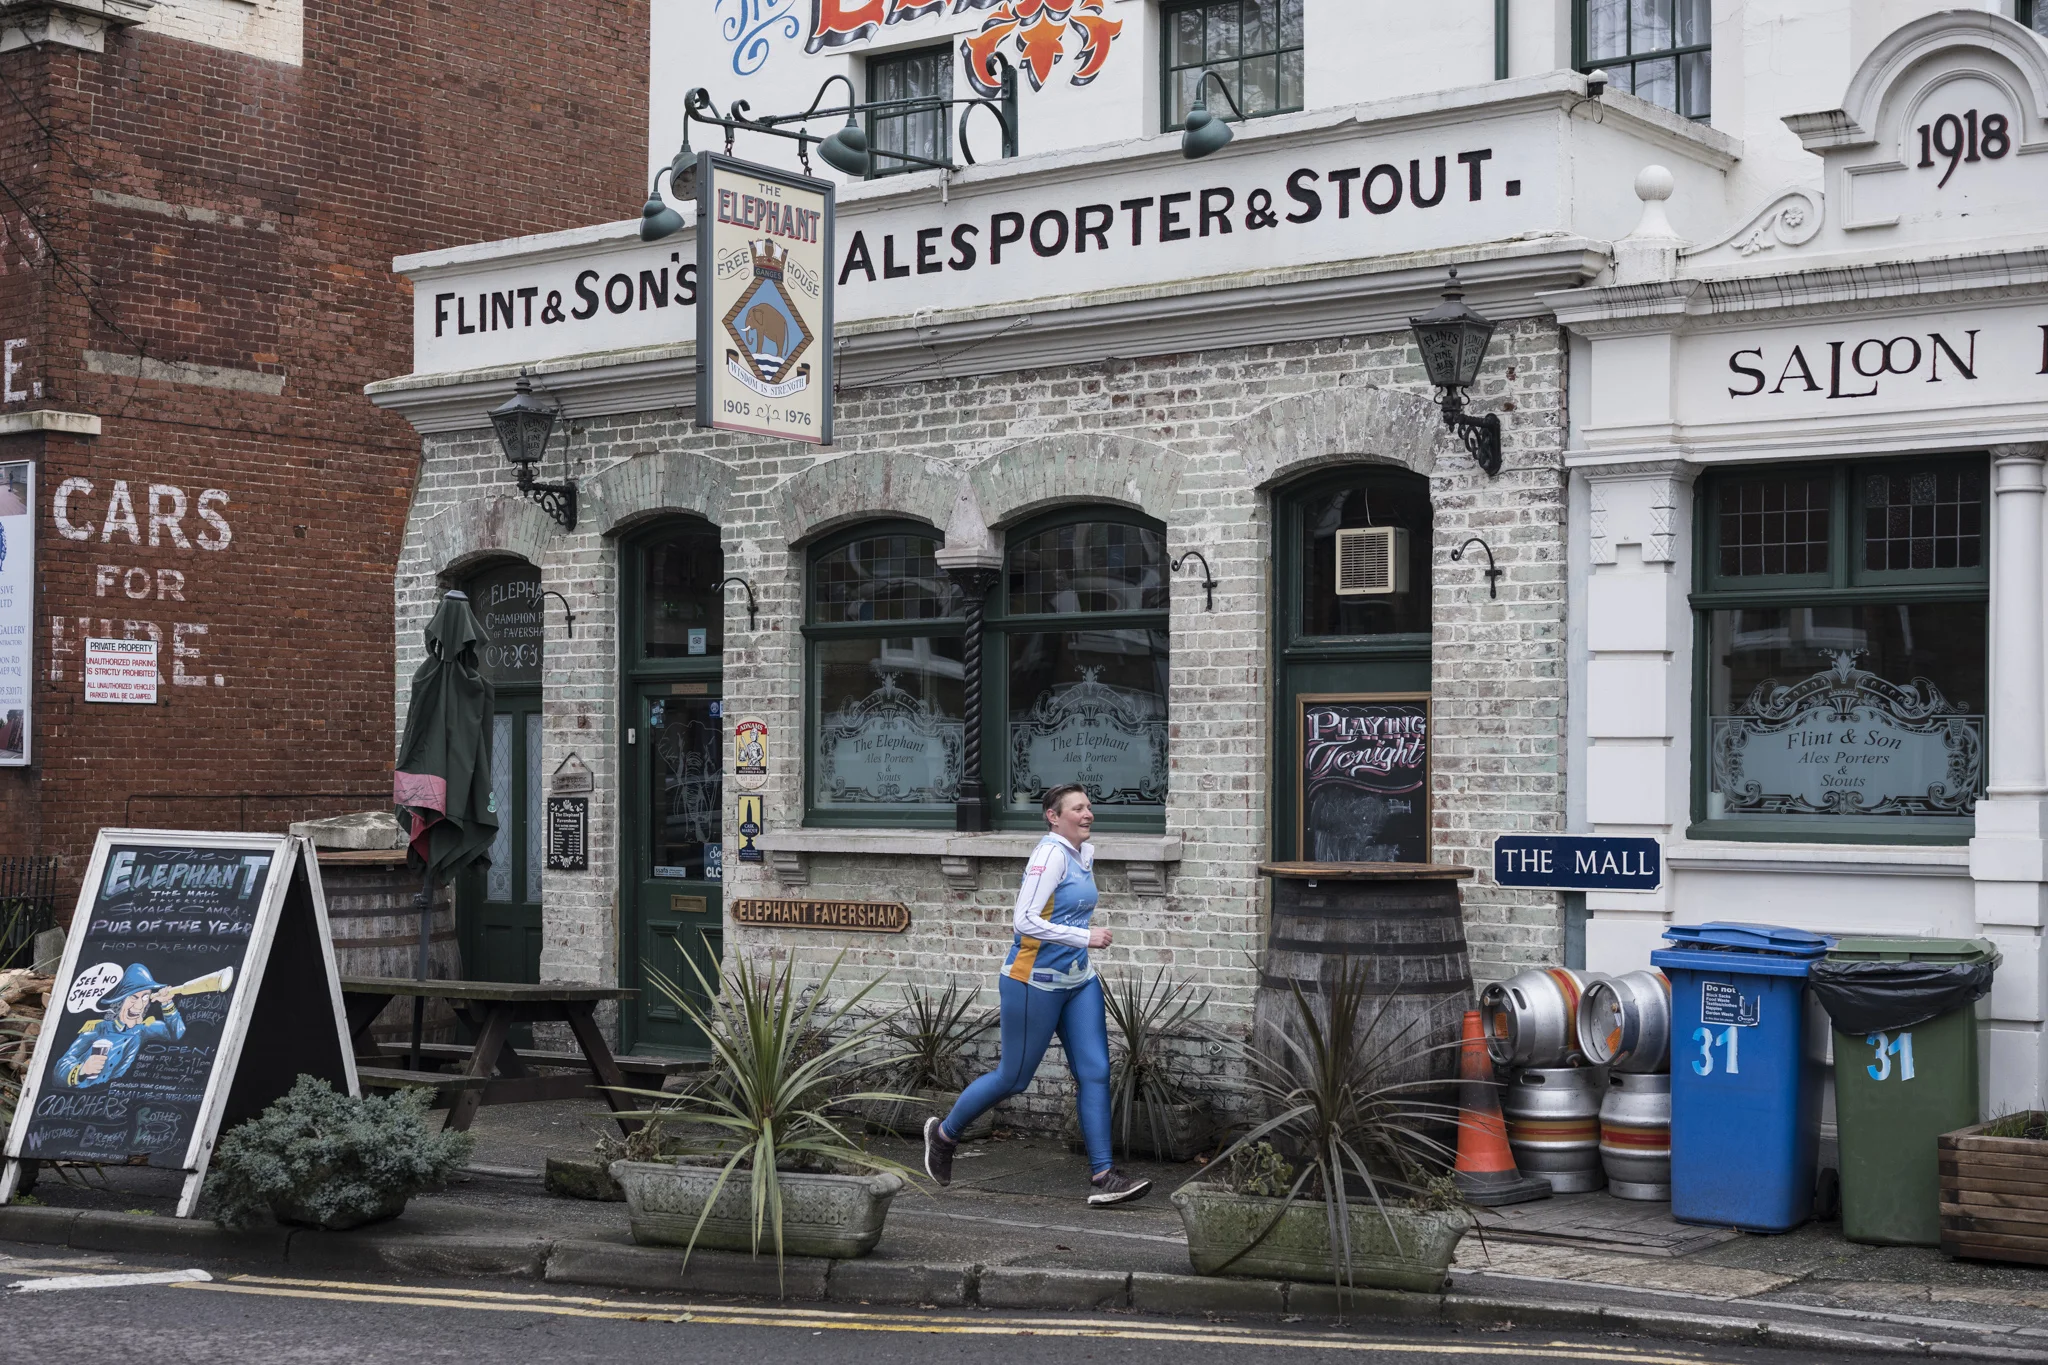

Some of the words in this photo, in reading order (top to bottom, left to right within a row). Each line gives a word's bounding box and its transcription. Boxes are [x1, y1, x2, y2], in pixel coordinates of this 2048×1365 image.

[1917, 109, 2011, 189] 1918
[758, 182, 781, 198] THE
[717, 187, 821, 244] ELEPHANT
[717, 251, 749, 276] FREE
[787, 260, 819, 297] HOUSE
[756, 267, 782, 280] GANGES
[1424, 331, 1459, 347] FLINTS
[1434, 350, 1453, 362] FINE
[1436, 360, 1454, 372] ALES
[1727, 329, 1981, 400] SALOON
[730, 362, 758, 390] WISDOM
[761, 383, 768, 393] IS
[770, 377, 804, 396] STRENGTH
[723, 399, 750, 416] 1905
[785, 409, 812, 425] 1976
[53, 476, 233, 551] CARS
[95, 564, 187, 602] FOR
[486, 612, 536, 630] CHAMPION
[493, 630, 501, 638] OF
[90, 642, 116, 650] PRIVATE
[118, 643, 152, 652] PROPERTY
[86, 658, 130, 666] UNAUTHORIZED
[132, 659, 156, 668] PARKING
[94, 668, 121, 676] STRICTLY
[122, 668, 156, 678] PROHIBITED
[96, 682, 132, 690] UNAUTHORIZED
[740, 722, 764, 732] ADNAMS
[1306, 710, 1427, 744] PLAYING
[854, 738, 872, 754] The
[876, 734, 925, 753] Elephant
[1050, 735, 1072, 752] The
[1076, 732, 1130, 752] Elephant
[1787, 730, 1834, 750] Flint
[1840, 728, 1858, 744] &
[1864, 730, 1902, 750] Son
[864, 752, 882, 764] Ales
[884, 752, 914, 764] Porters
[1062, 752, 1082, 762] Ales
[1084, 752, 1118, 762] Porters
[1305, 736, 1426, 779] Tonight
[1798, 751, 1830, 764] Ales
[1834, 751, 1890, 764] Porters
[886, 764, 892, 772] &
[1086, 764, 1093, 772] &
[1837, 764, 1848, 776] &
[876, 772, 902, 782] Stouts
[1076, 772, 1104, 782] Stouts
[1820, 774, 1866, 788] Stouts
[159, 849, 216, 861] The
[1501, 848, 1554, 874] THE
[1574, 850, 1655, 876] MALL
[101, 851, 271, 900] ELEPHANT
[178, 905, 241, 918] CAMRA
[738, 900, 809, 923] ELEPHANT
[813, 902, 898, 927] FAVERSHAM
[89, 919, 132, 936] PUB
[136, 920, 164, 933] OF
[164, 920, 202, 933] THE
[208, 920, 253, 936] YEAR
[98, 966, 104, 976] I
[76, 976, 98, 988] SEE
[102, 976, 118, 984] NO
[1706, 984, 1719, 992] Do
[69, 988, 106, 1002] SHEPS
[178, 992, 233, 1010] NELSON
[186, 1010, 224, 1022] BREWERY
[144, 1044, 210, 1056] OPEN
[1691, 1025, 1739, 1077] 31
[1866, 1031, 1915, 1082] 31
[108, 1089, 163, 1100] FAMILIES
[166, 1092, 203, 1100] WELCOME
[136, 1106, 182, 1126] ROTHER
[28, 1126, 81, 1150] WHITSTABLE
[79, 1124, 128, 1148] BREWERY
[132, 1127, 176, 1146] VALLEY
